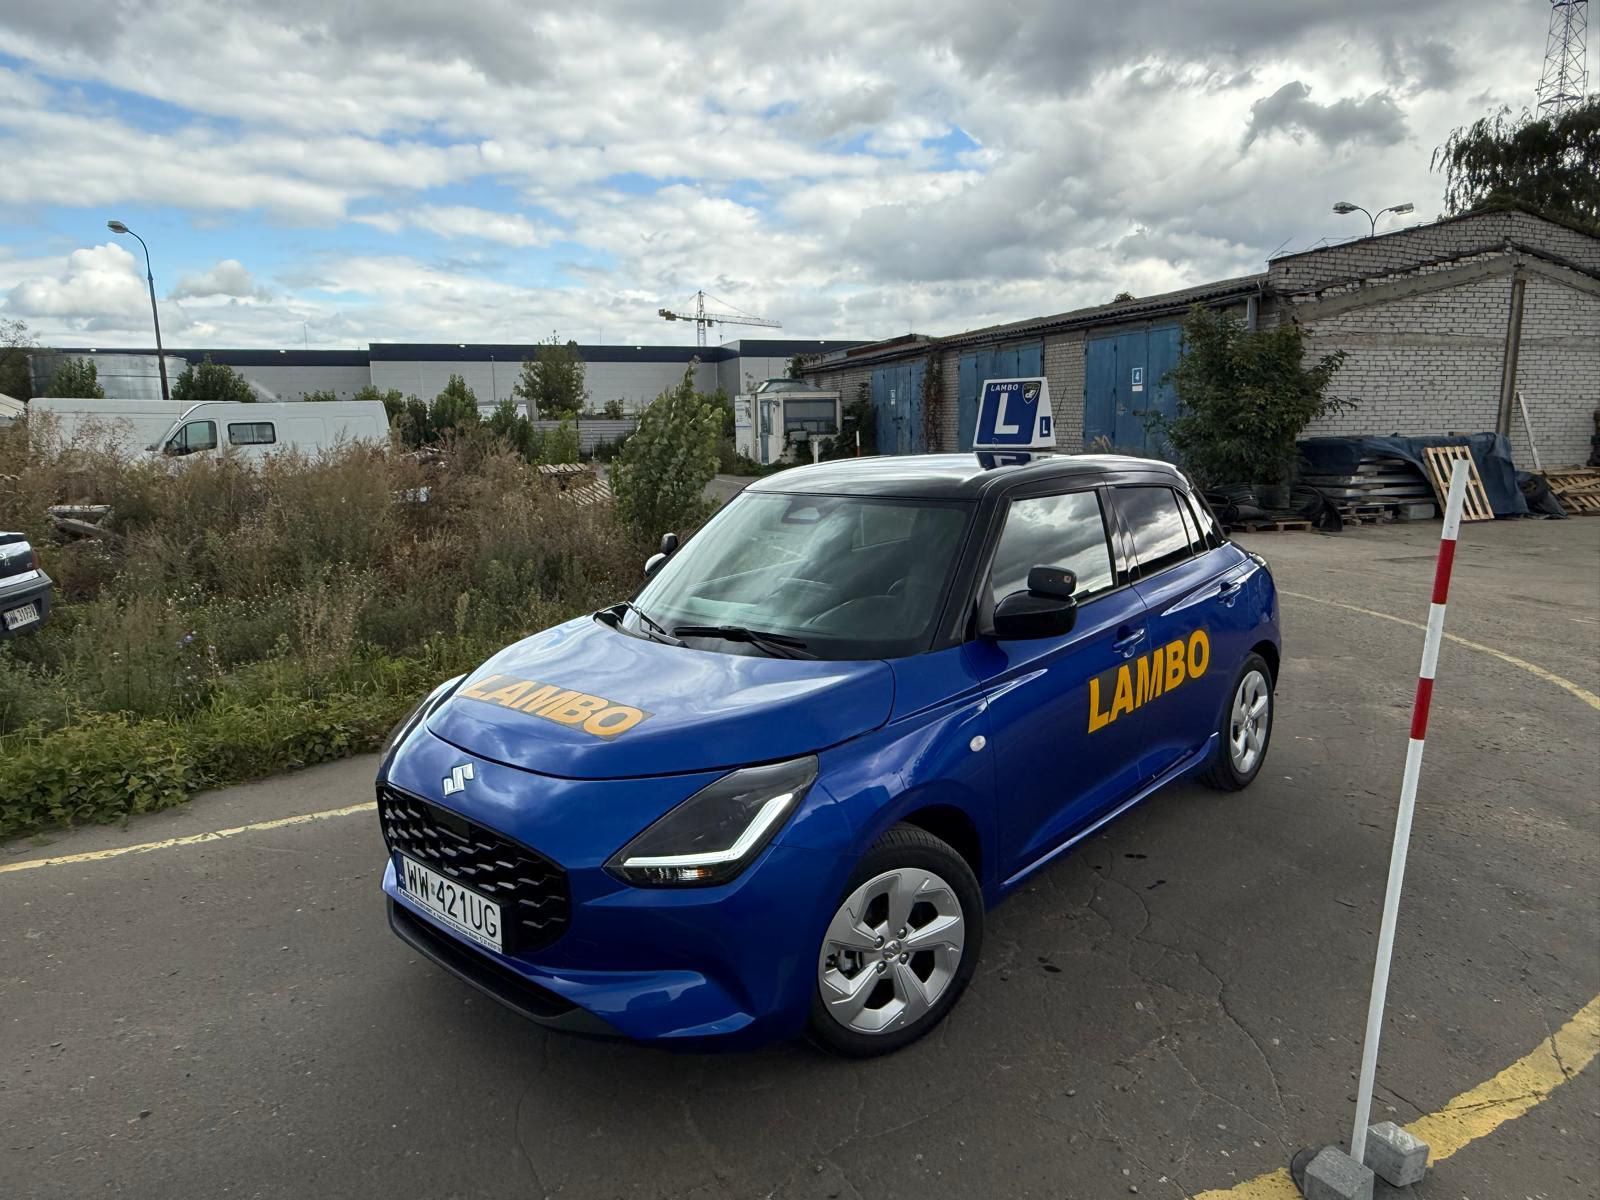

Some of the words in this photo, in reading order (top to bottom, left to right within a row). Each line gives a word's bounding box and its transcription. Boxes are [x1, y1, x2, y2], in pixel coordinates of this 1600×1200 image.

[994, 393, 1019, 434] L
[1043, 420, 1048, 434] L
[459, 674, 643, 735] LAMBO
[1088, 630, 1210, 734] LAMBO
[407, 861, 429, 901] WW
[436, 880, 497, 937] 421UG
